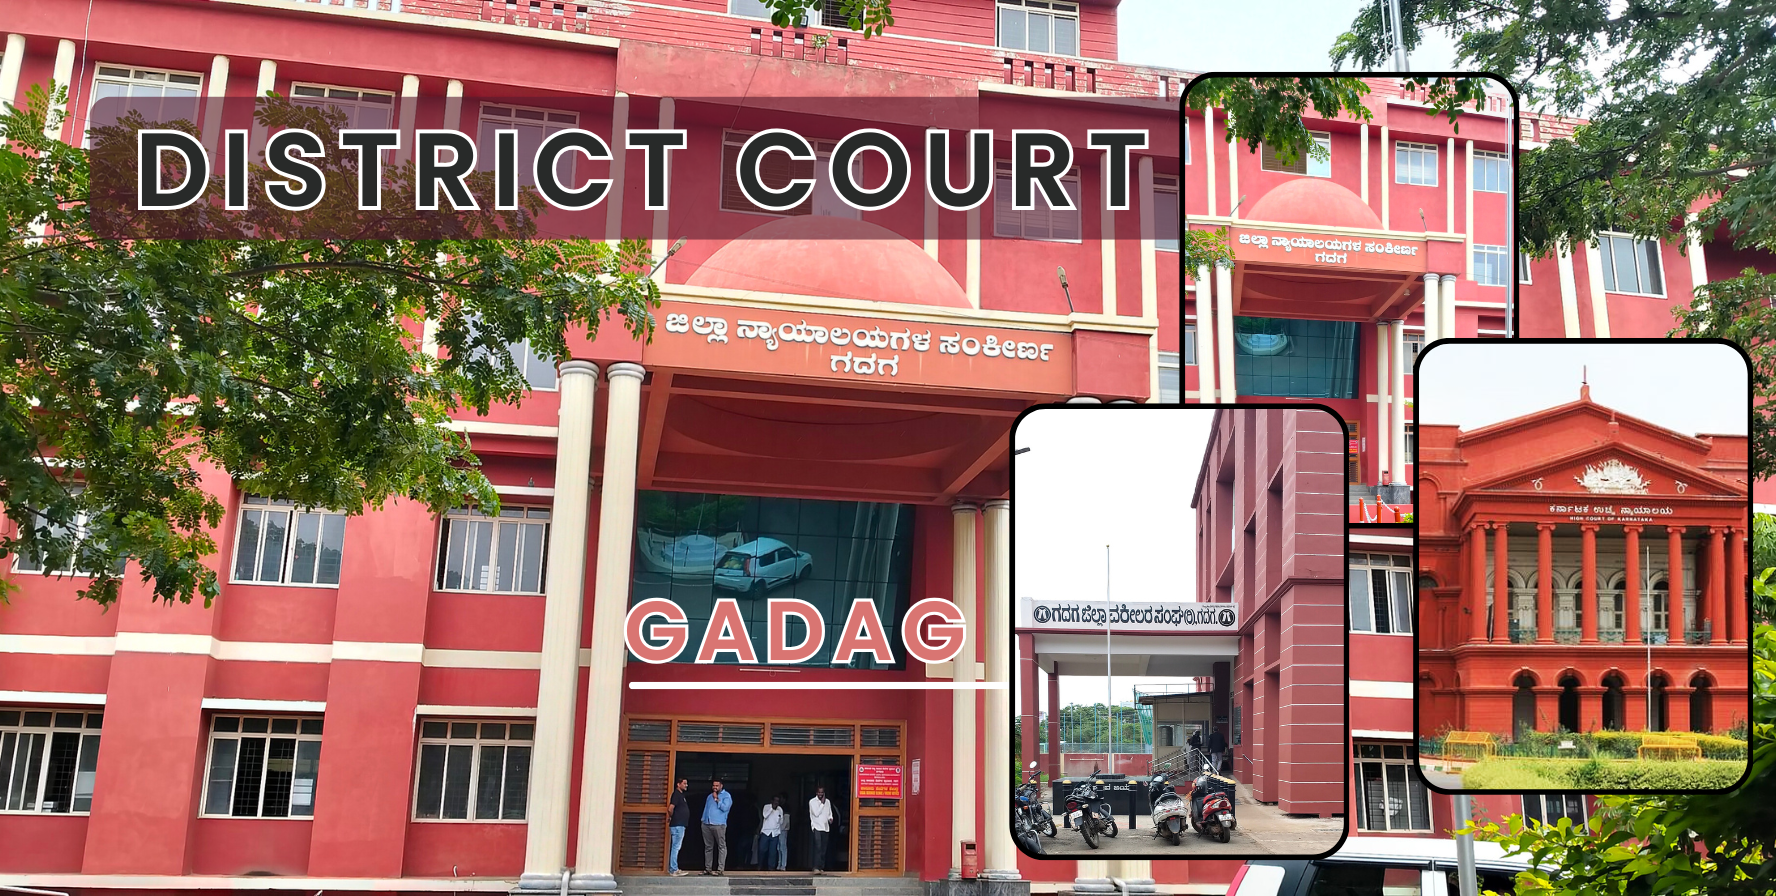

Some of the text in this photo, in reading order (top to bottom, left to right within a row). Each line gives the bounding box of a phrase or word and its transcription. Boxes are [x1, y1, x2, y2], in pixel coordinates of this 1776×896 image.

[1239, 233, 1418, 256] ಜಿಲ್ಲಾ ನ್ಯಾಯಾಲಯಗಳ ಸಂಕೀರ್ಣ
[1315, 252, 1347, 264] ಗದಗ
[665, 311, 1054, 361] ಜಿಲ್ಲಾ ನ್ಯಾಯಾಲಯಗಳ ಸಂಕೀರ್ಣ
[830, 350, 899, 376] ಗದಗ
[1051, 603, 1080, 623] ಗದಗ
[1109, 603, 1153, 624] ವಕೀಲರ
